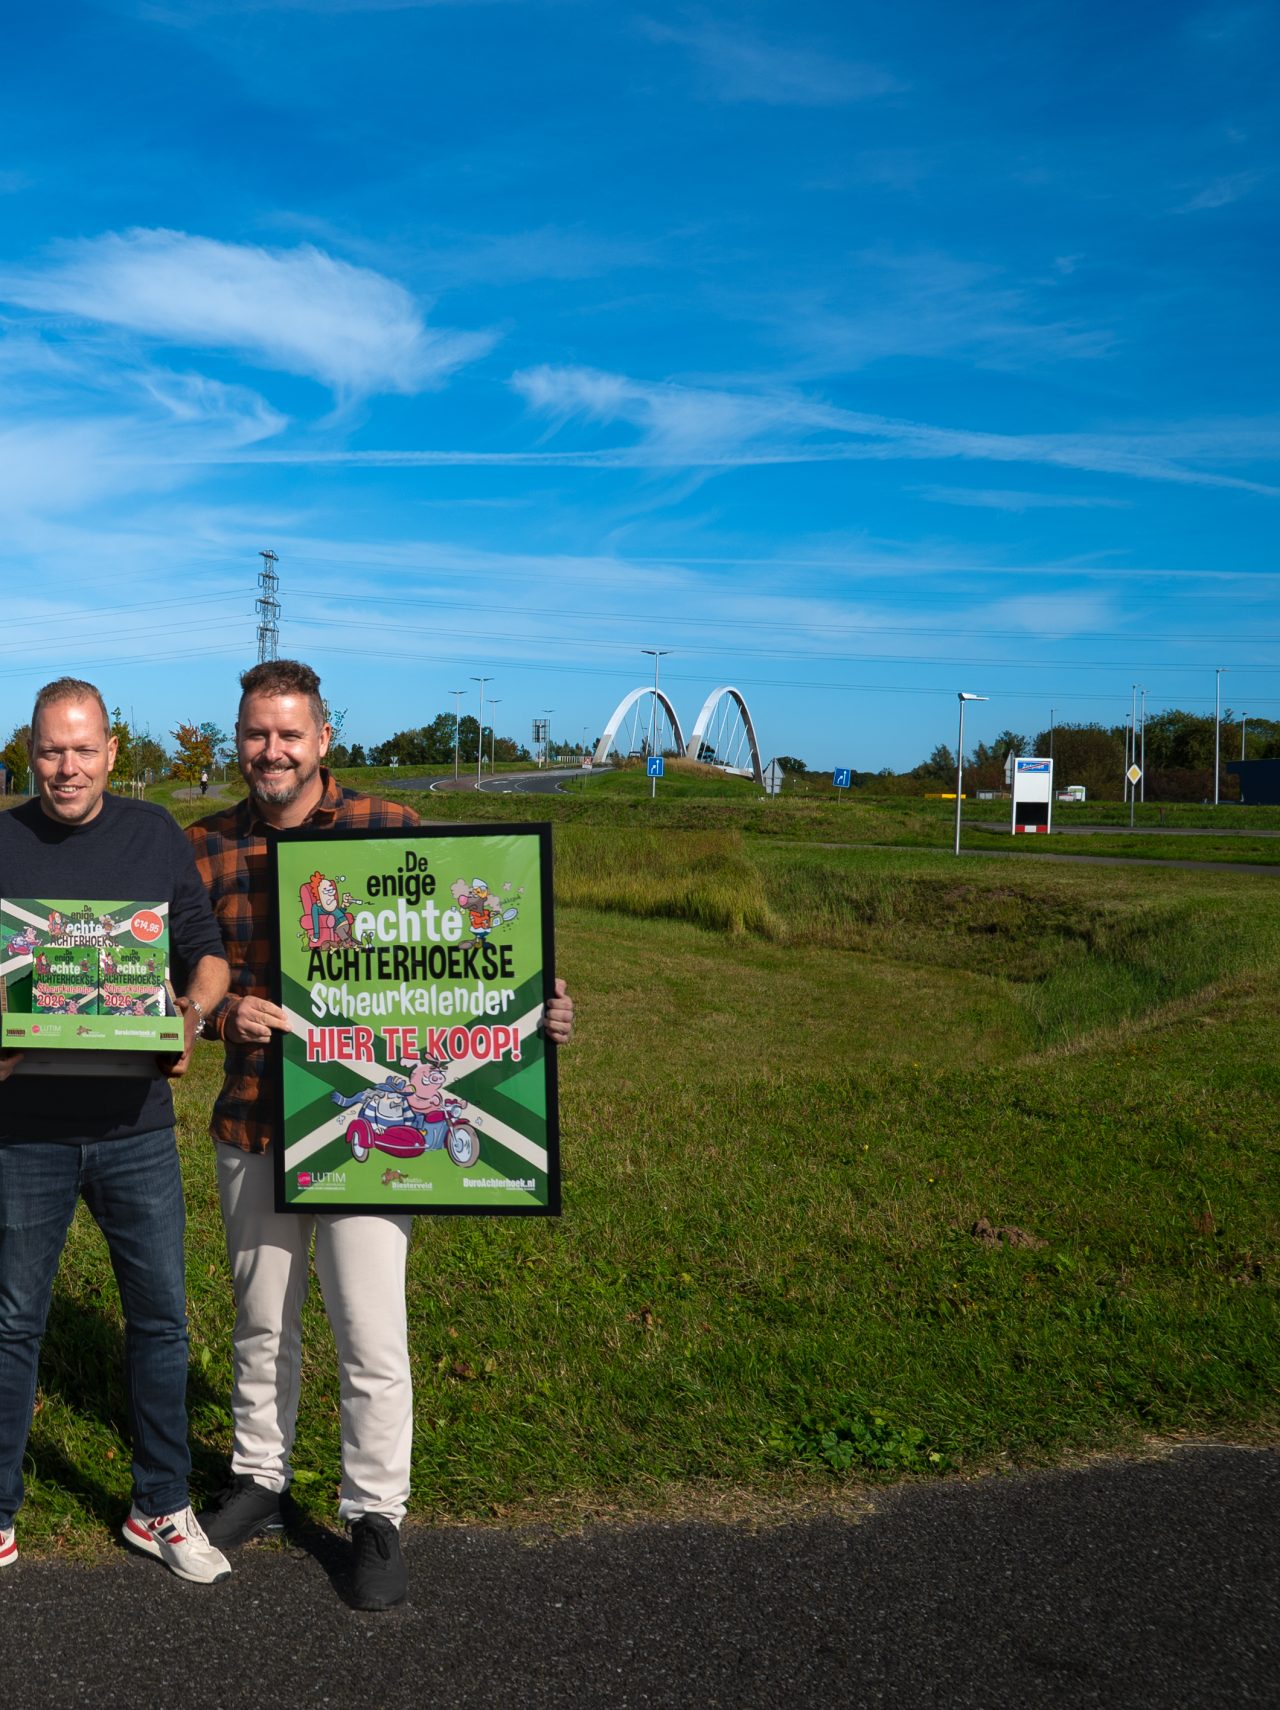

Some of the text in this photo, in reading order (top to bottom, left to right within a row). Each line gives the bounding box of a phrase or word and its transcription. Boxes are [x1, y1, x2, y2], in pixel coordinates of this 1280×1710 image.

[405, 851, 428, 872] De
[366, 867, 436, 906] enige
[71, 908, 94, 920] enige
[354, 898, 463, 943] echte
[66, 920, 103, 935] echte
[50, 961, 80, 974] echte
[117, 961, 146, 975] echte
[307, 944, 516, 982] ACHTERHOEKSE
[37, 994, 65, 1007] 2026
[104, 994, 132, 1007] 2026
[310, 980, 516, 1018] Scheurkalender
[306, 1025, 522, 1062] HIER TE KOOP!
[311, 1172, 346, 1183] LUTIM
